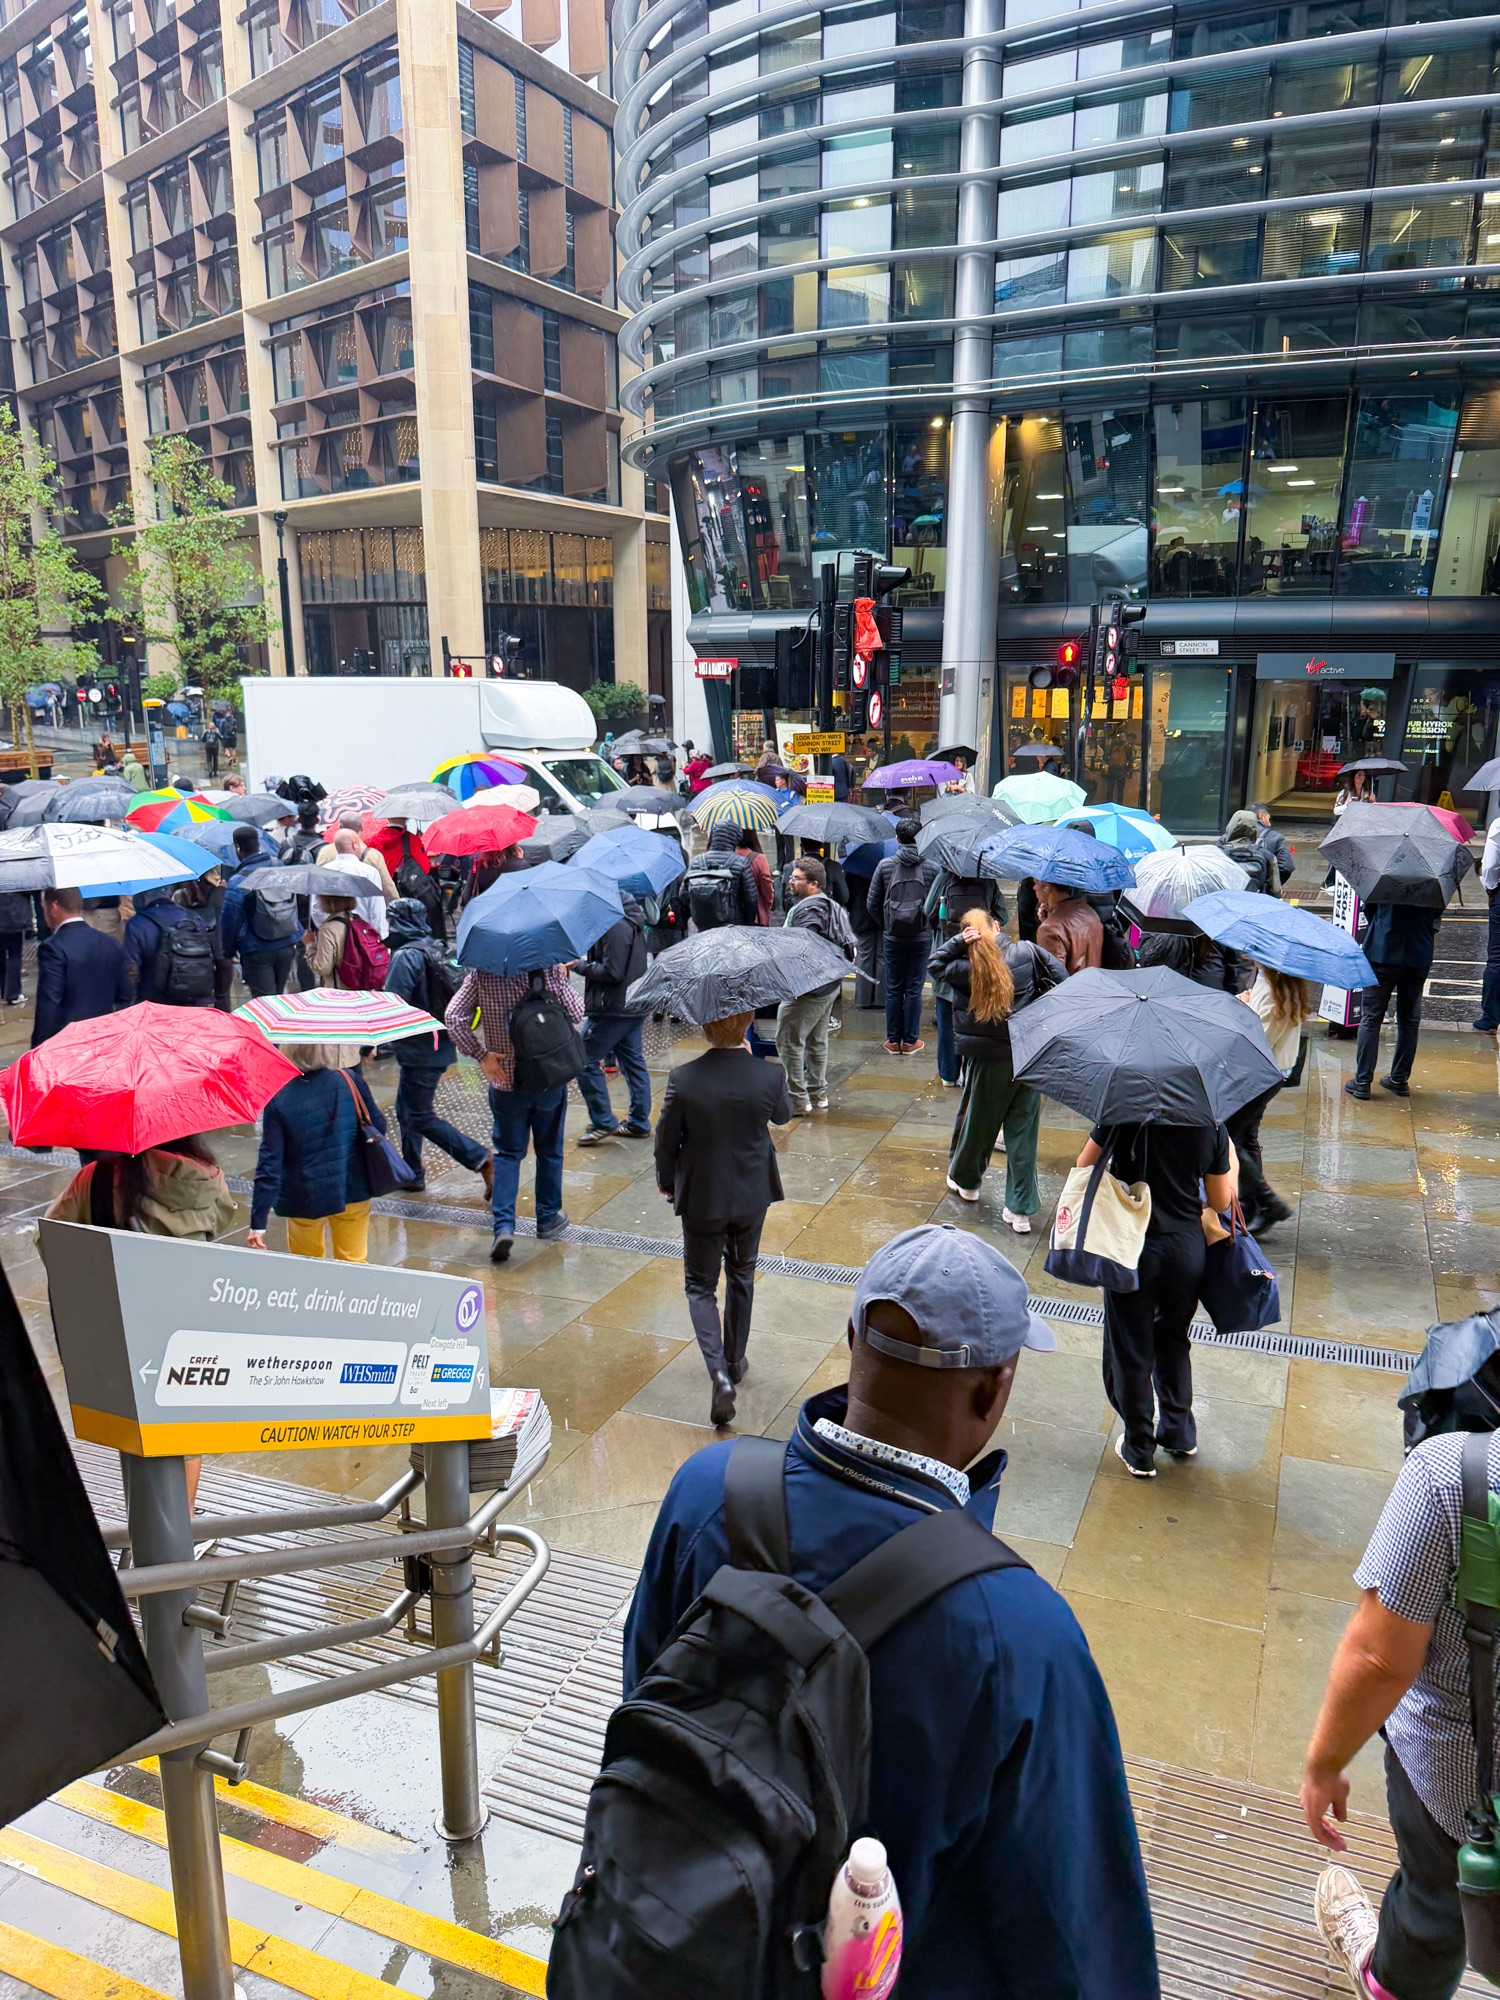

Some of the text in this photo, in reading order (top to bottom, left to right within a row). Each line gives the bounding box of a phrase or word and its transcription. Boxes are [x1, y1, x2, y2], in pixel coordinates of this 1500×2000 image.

[1305, 657, 1328, 675] Virgin
[900, 775, 923, 784] evelyn
[1341, 880, 1349, 920] POST
[209, 1277, 422, 1319] Shop, eat, drink and travel
[430, 1339, 467, 1351] Dowgate Hill
[190, 1355, 219, 1365] CAFFÈ
[247, 1356, 333, 1372] wetherspoon
[411, 1355, 430, 1369] PELT
[166, 1366, 230, 1386] NERO
[250, 1375, 325, 1386] The Sir John Hawkshaw
[342, 1364, 396, 1384] WHSmith
[441, 1368, 472, 1379] GREGGS
[410, 1386, 419, 1394] Bar
[422, 1398, 448, 1408] Next left
[260, 1422, 416, 1444] CAUTION! WATCH YOUR STEP
[844, 1467, 894, 1494] CRAGHOPPERS
[854, 1899, 872, 1910] ZERO
